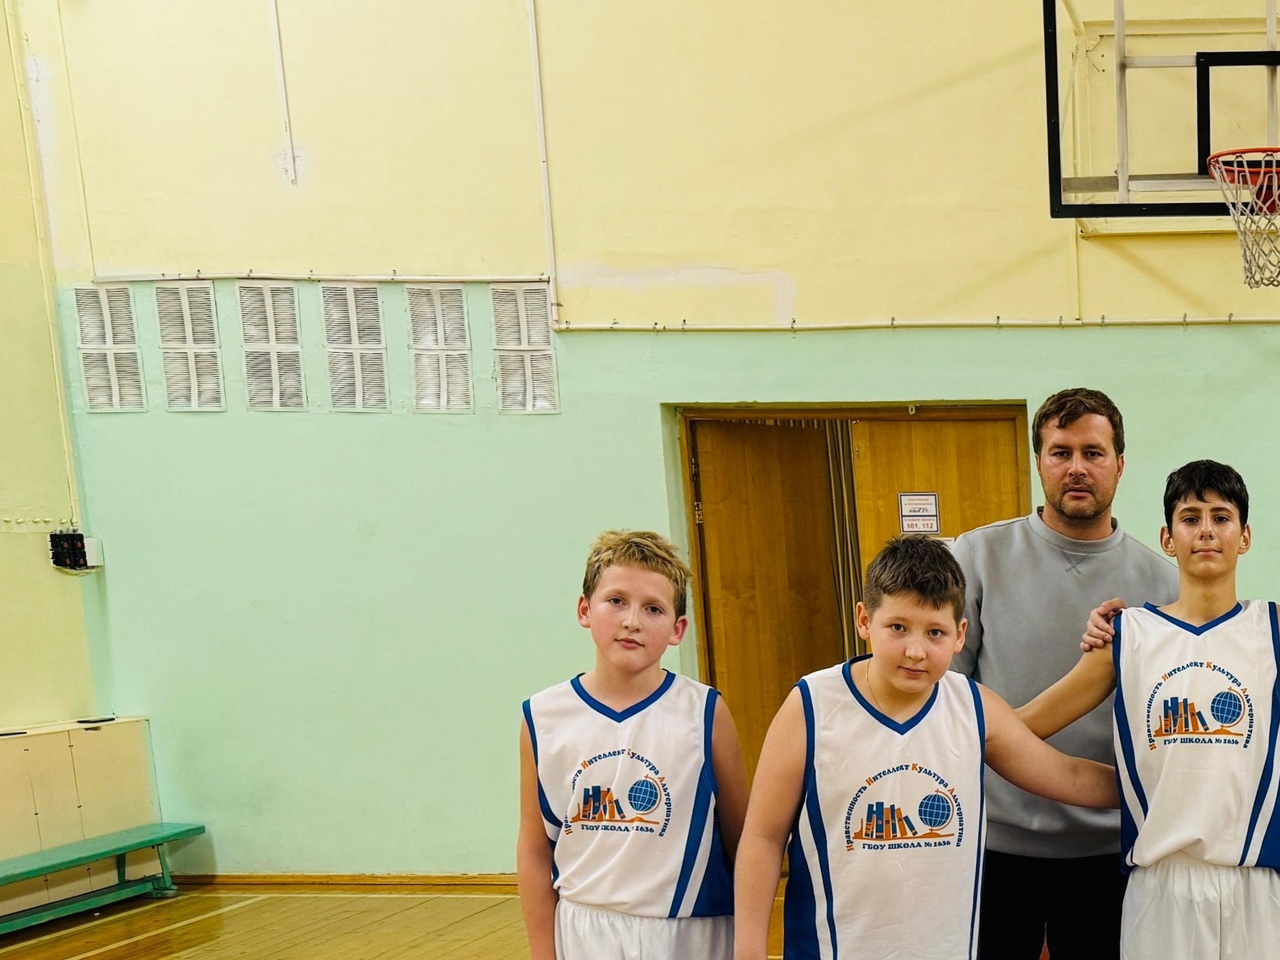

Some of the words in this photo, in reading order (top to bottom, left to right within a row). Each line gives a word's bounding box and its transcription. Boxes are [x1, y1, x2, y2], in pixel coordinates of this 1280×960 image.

[1205, 661, 1242, 688] Культура
[865, 763, 910, 787] Интеллект
[911, 763, 949, 788] Культура
[862, 842, 886, 851] ГБОУ
[887, 842, 922, 850] ШКОЛА
[933, 840, 952, 848] 1636
